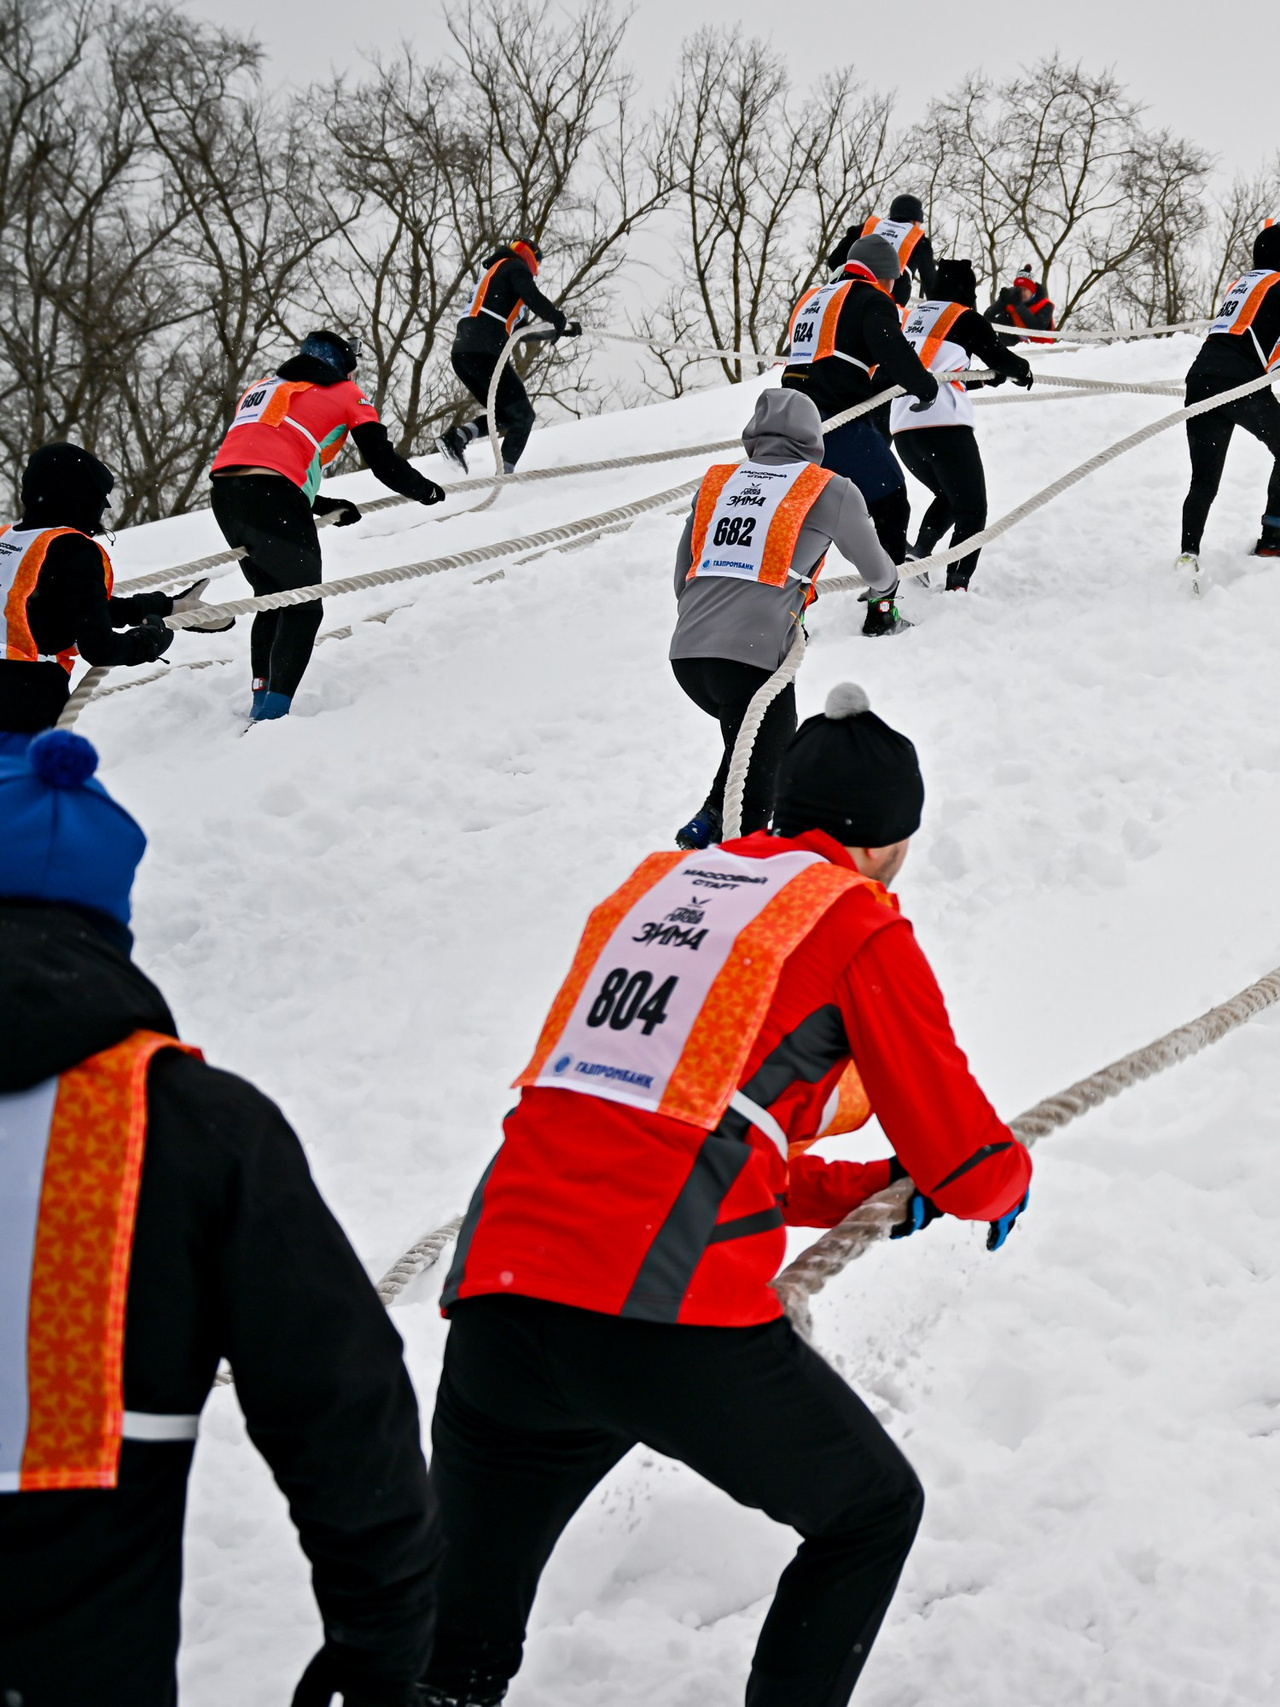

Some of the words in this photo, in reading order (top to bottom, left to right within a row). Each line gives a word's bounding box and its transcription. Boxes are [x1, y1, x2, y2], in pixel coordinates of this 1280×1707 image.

[793, 322, 814, 343] 624
[726, 495, 767, 507] ЗИМА
[713, 517, 756, 547] 682
[713, 560, 754, 570] ГАЗПРОМБАНК
[692, 879, 740, 890] СТАРТ
[632, 922, 709, 950] ЗИМА
[586, 967, 679, 1036] 804
[575, 1061, 654, 1089] ГАЗПРОМБАНК
